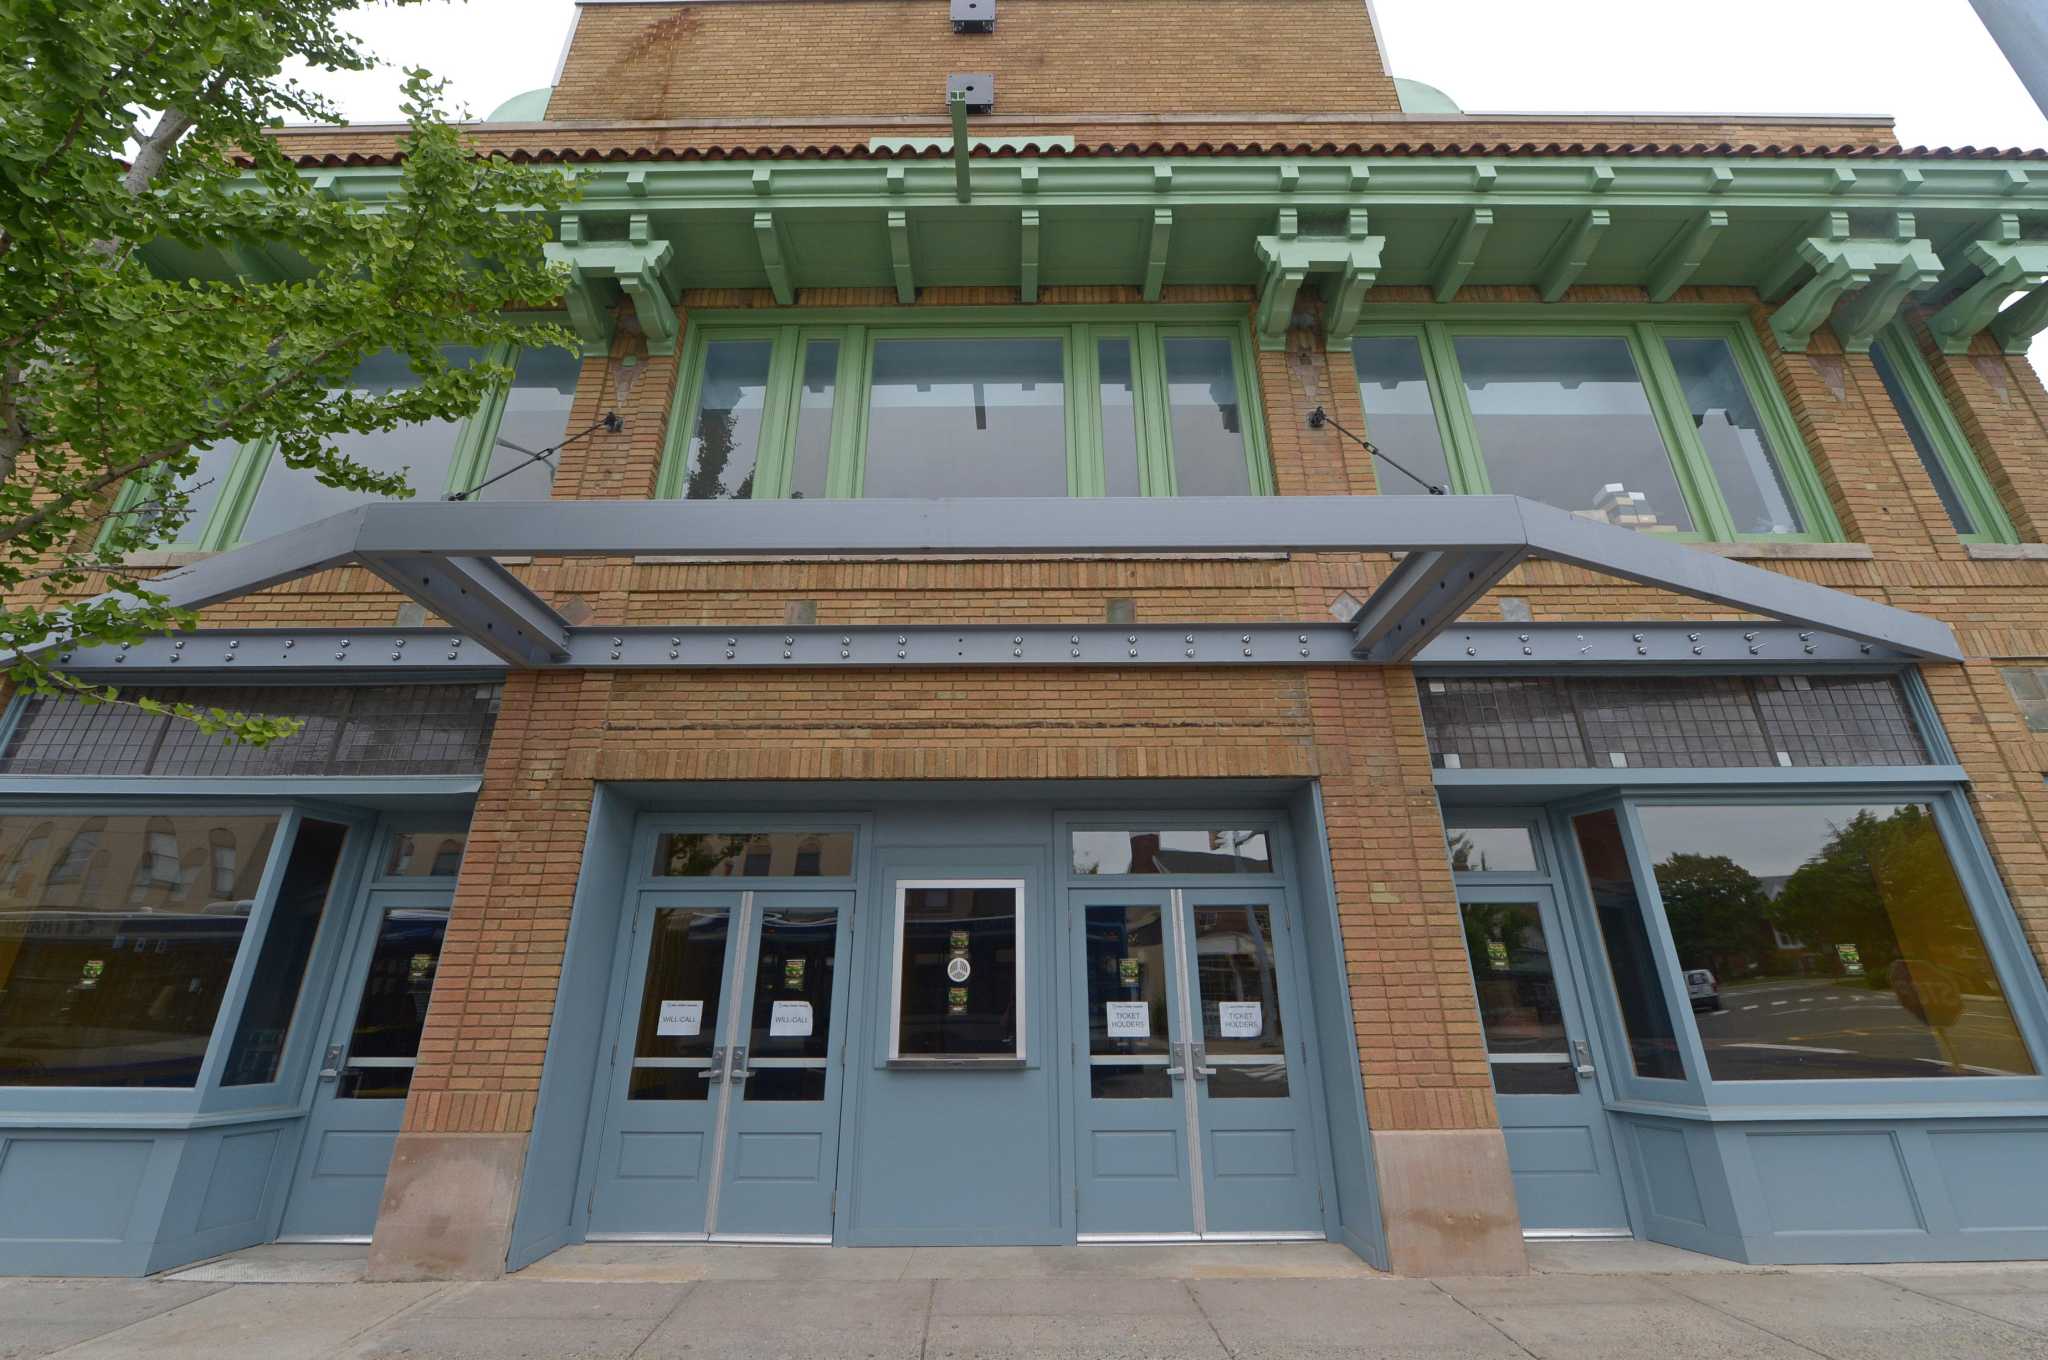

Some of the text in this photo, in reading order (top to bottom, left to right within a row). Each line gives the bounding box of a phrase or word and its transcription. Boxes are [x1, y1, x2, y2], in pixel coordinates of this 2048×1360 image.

[775, 1016, 808, 1024] WILL CALL
[1116, 1012, 1140, 1020] TICKET
[1229, 1012, 1254, 1020] TICKET
[1111, 1020, 1145, 1028] HOLDERS
